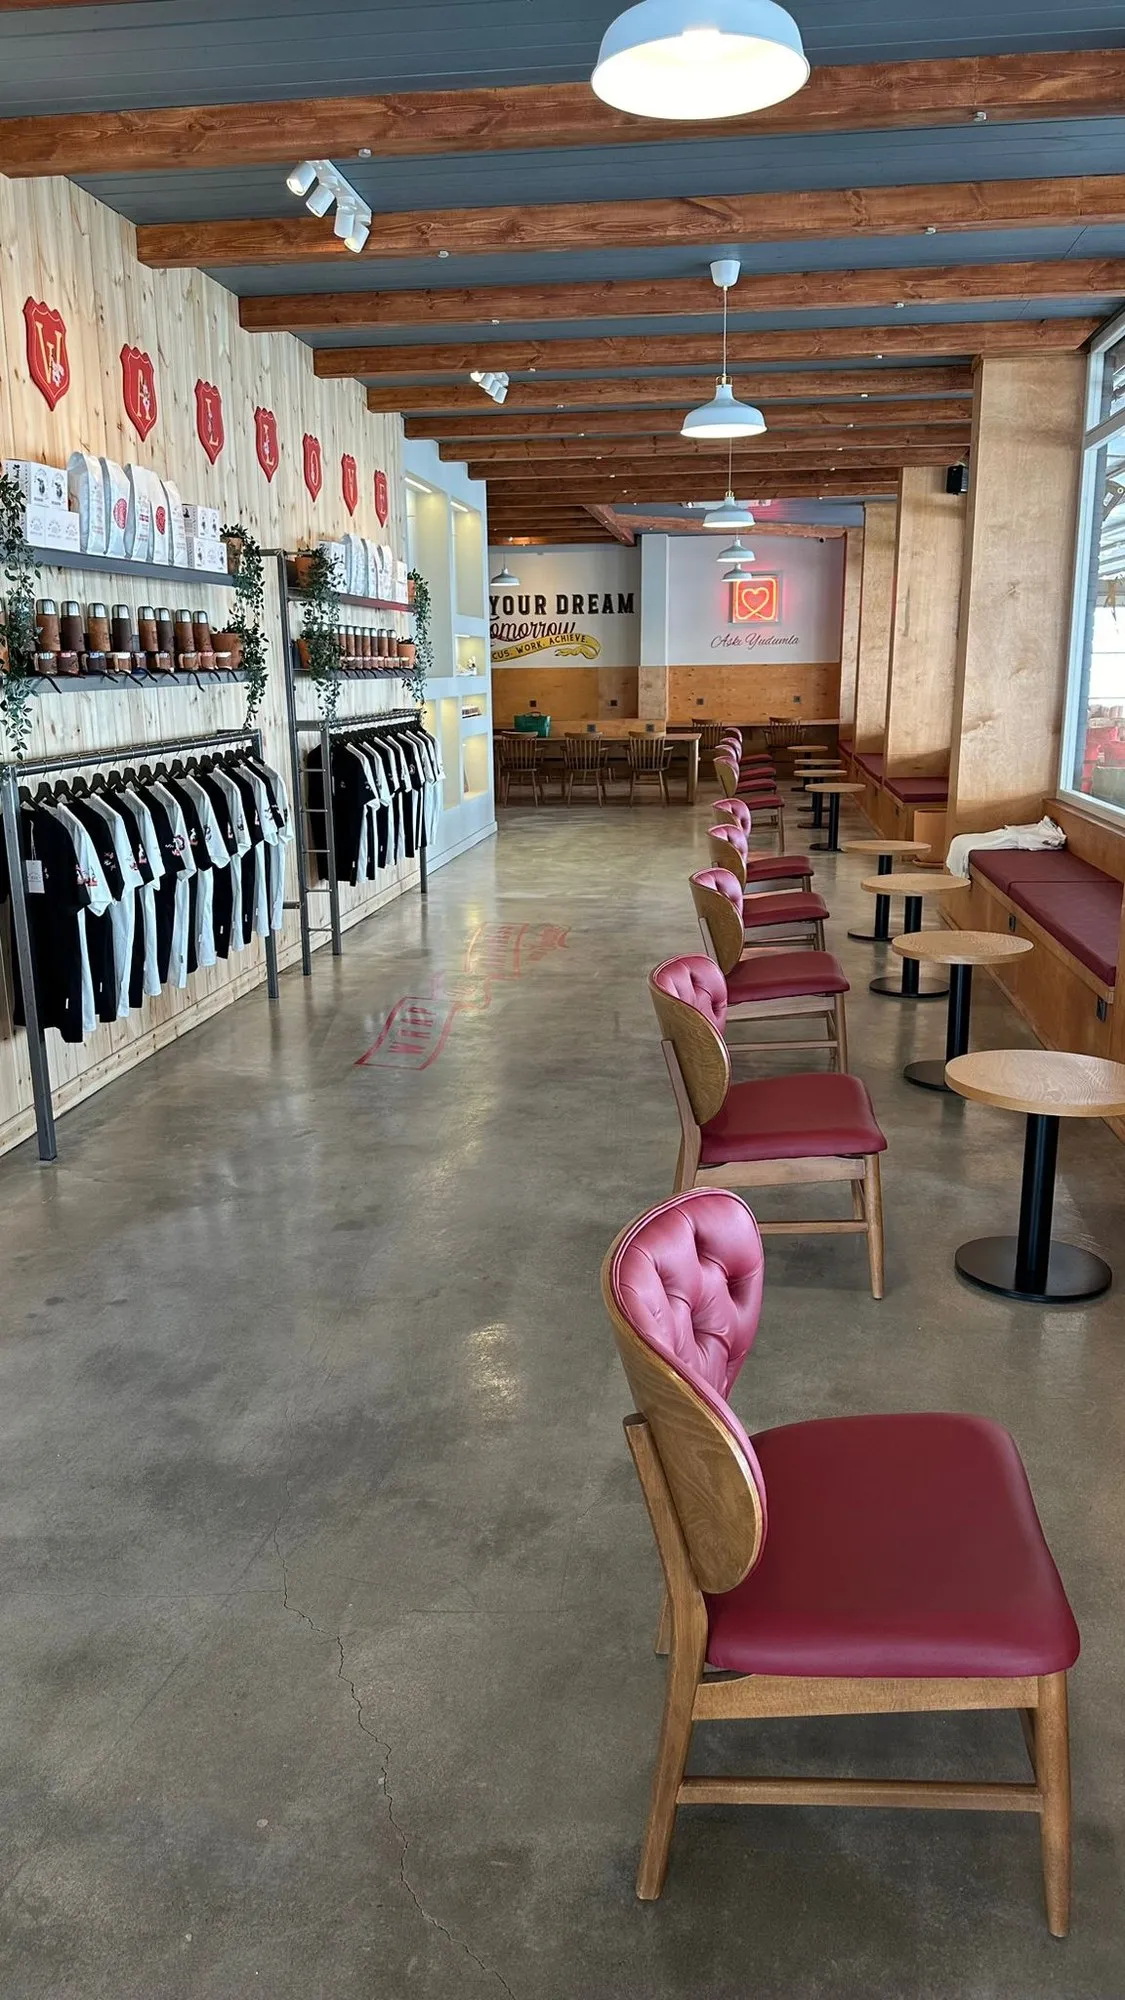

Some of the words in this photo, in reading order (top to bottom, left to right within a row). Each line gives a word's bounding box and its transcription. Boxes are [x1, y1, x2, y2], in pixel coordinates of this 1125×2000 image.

[489, 594, 548, 615] YOUR
[556, 592, 636, 615] DREAM
[490, 620, 576, 642] omorrow
[491, 649, 513, 660] CUS.
